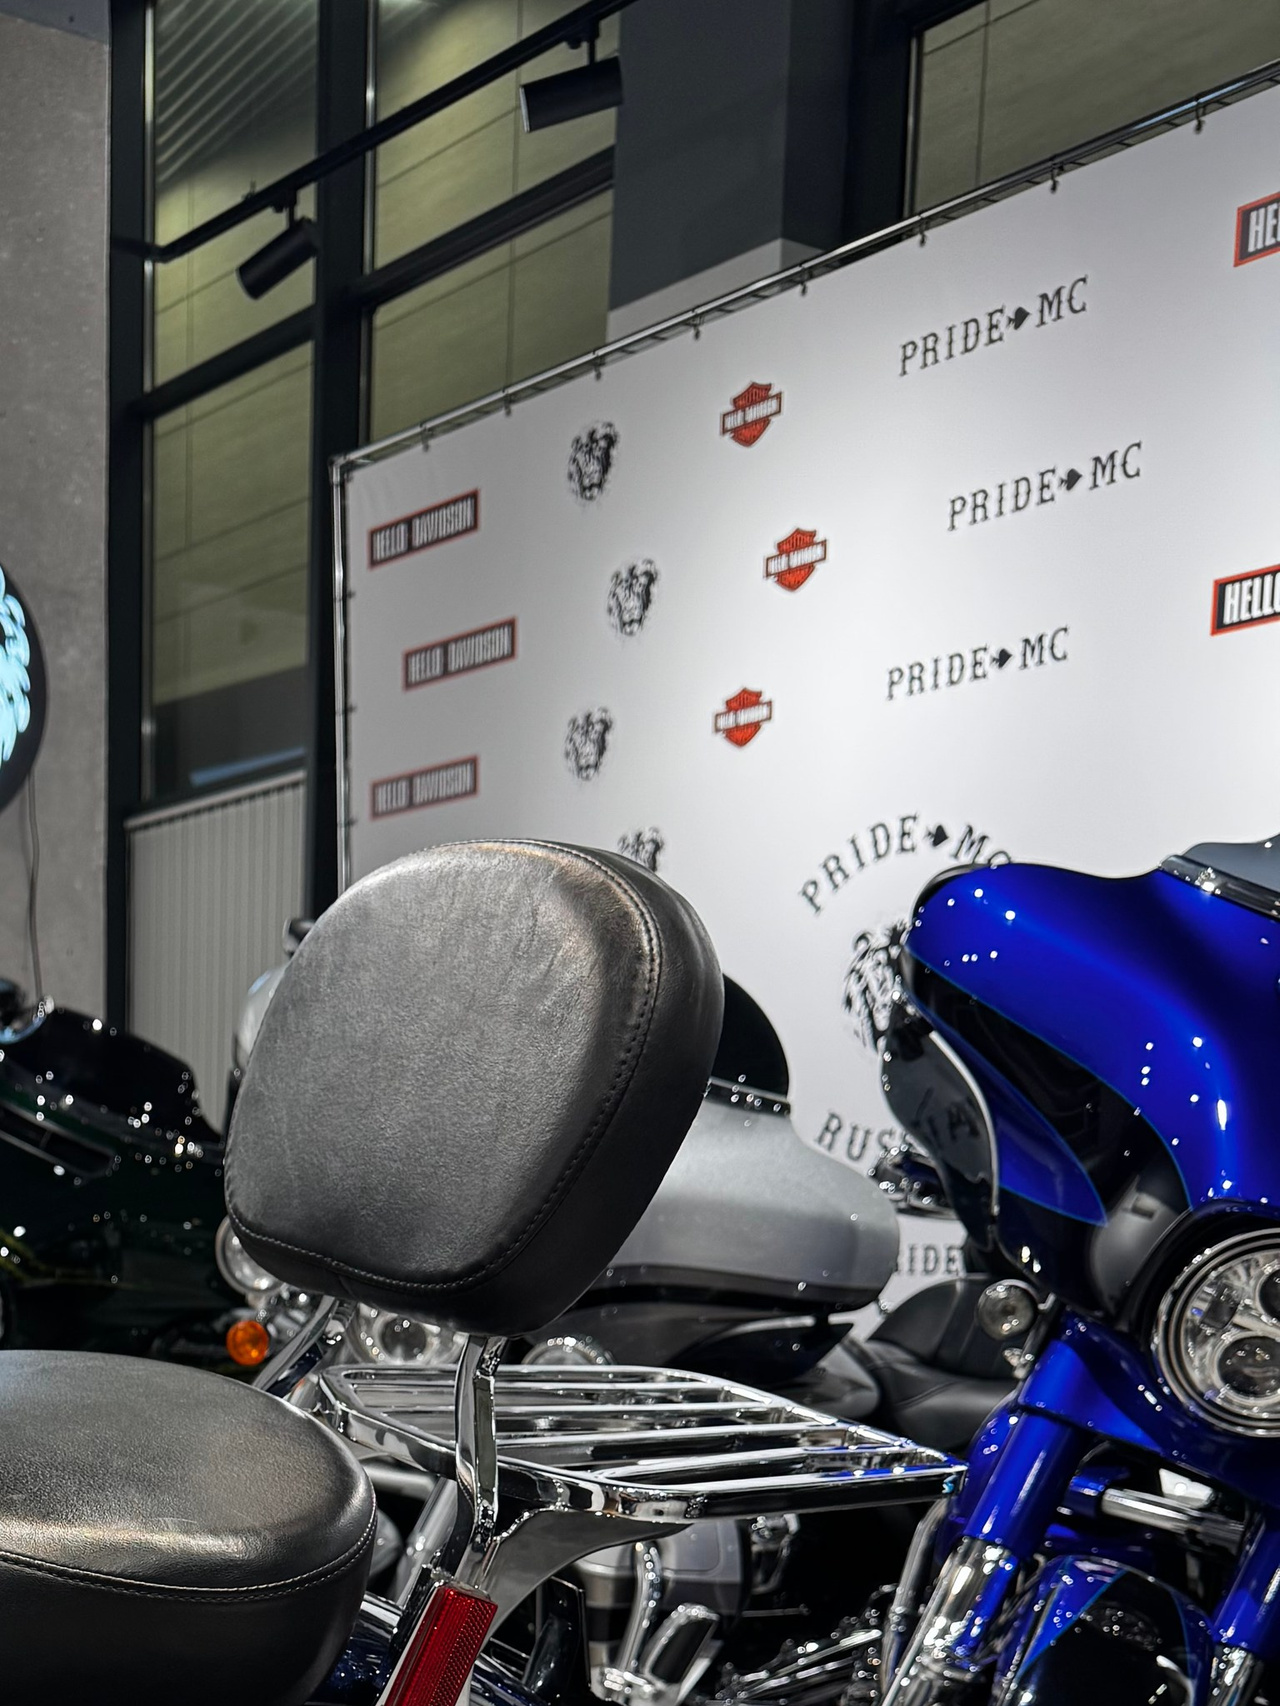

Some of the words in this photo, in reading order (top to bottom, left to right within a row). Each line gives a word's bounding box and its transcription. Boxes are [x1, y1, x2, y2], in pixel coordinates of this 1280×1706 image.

[1248, 203, 1280, 252] HE
[899, 305, 1005, 377] PRIDE
[1035, 275, 1088, 327] MC
[947, 465, 1056, 531] PRIDE
[1088, 440, 1142, 490] MC
[886, 644, 990, 701] PRIDE
[1019, 625, 1070, 670] MC
[799, 812, 920, 914] PRIDE
